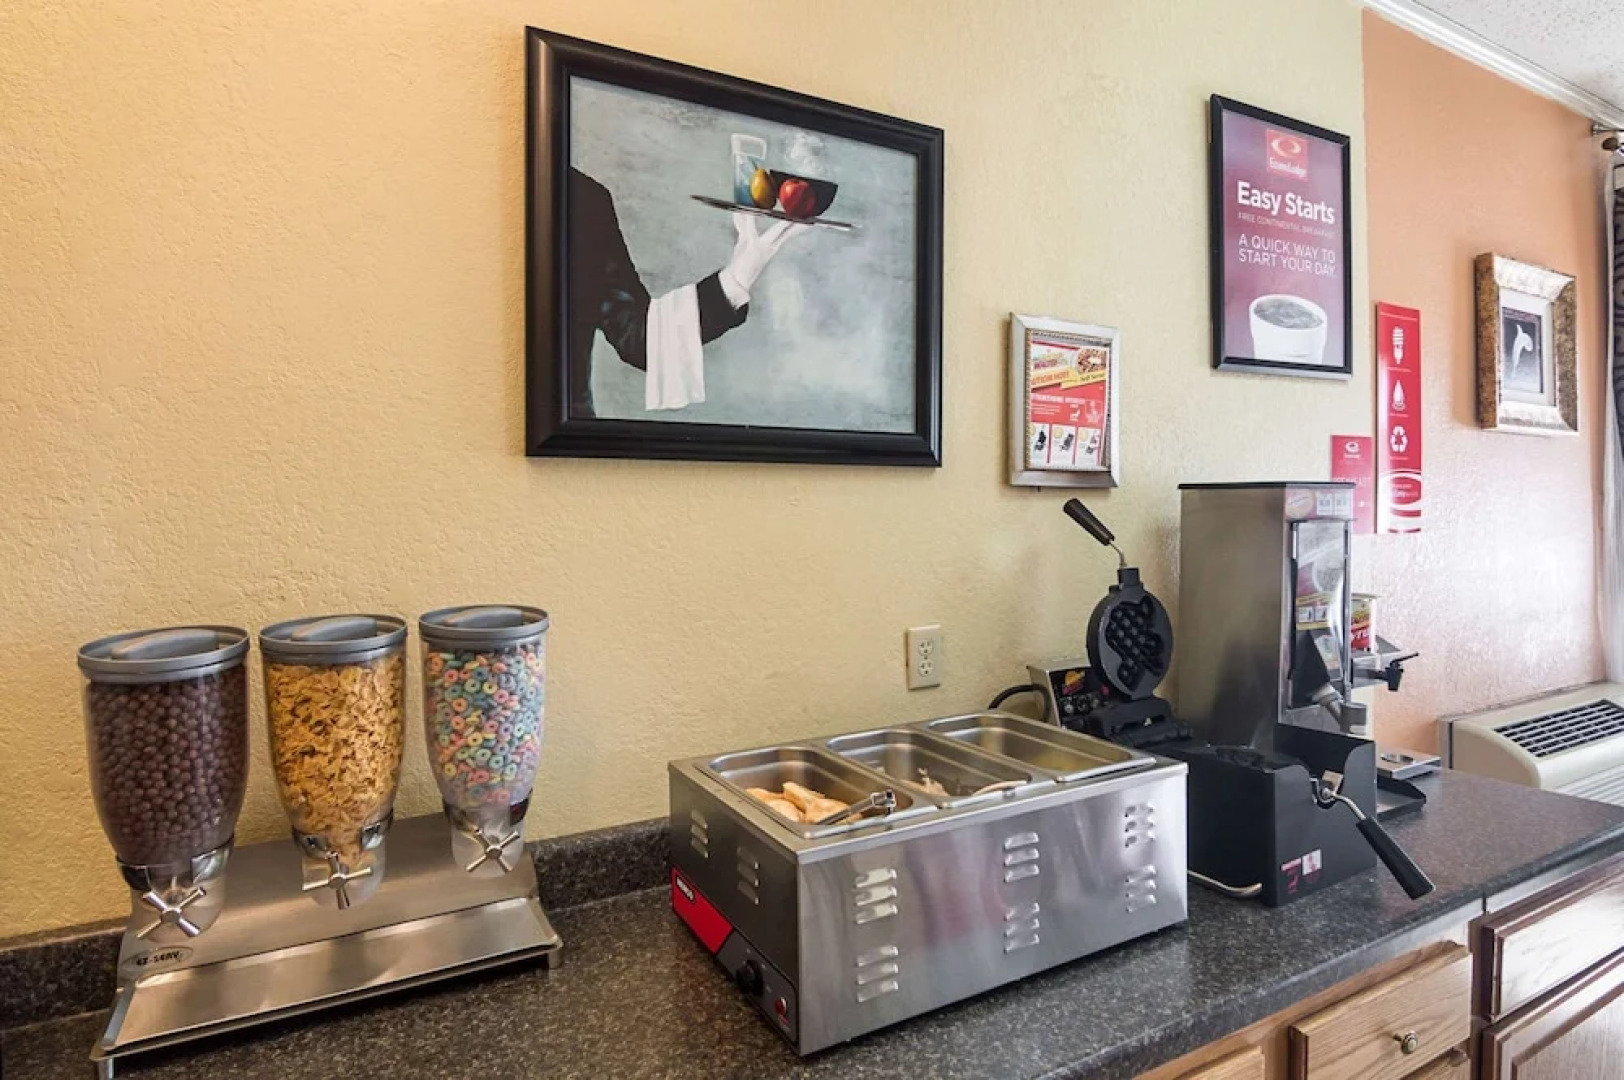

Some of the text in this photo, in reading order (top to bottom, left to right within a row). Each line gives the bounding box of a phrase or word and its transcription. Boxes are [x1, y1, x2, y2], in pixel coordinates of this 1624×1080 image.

[1237, 180, 1335, 225] Easy Starts
[1238, 233, 1335, 264] A QUICK WAY TO
[1238, 248, 1277, 267] START
[1280, 255, 1312, 273] YOUR
